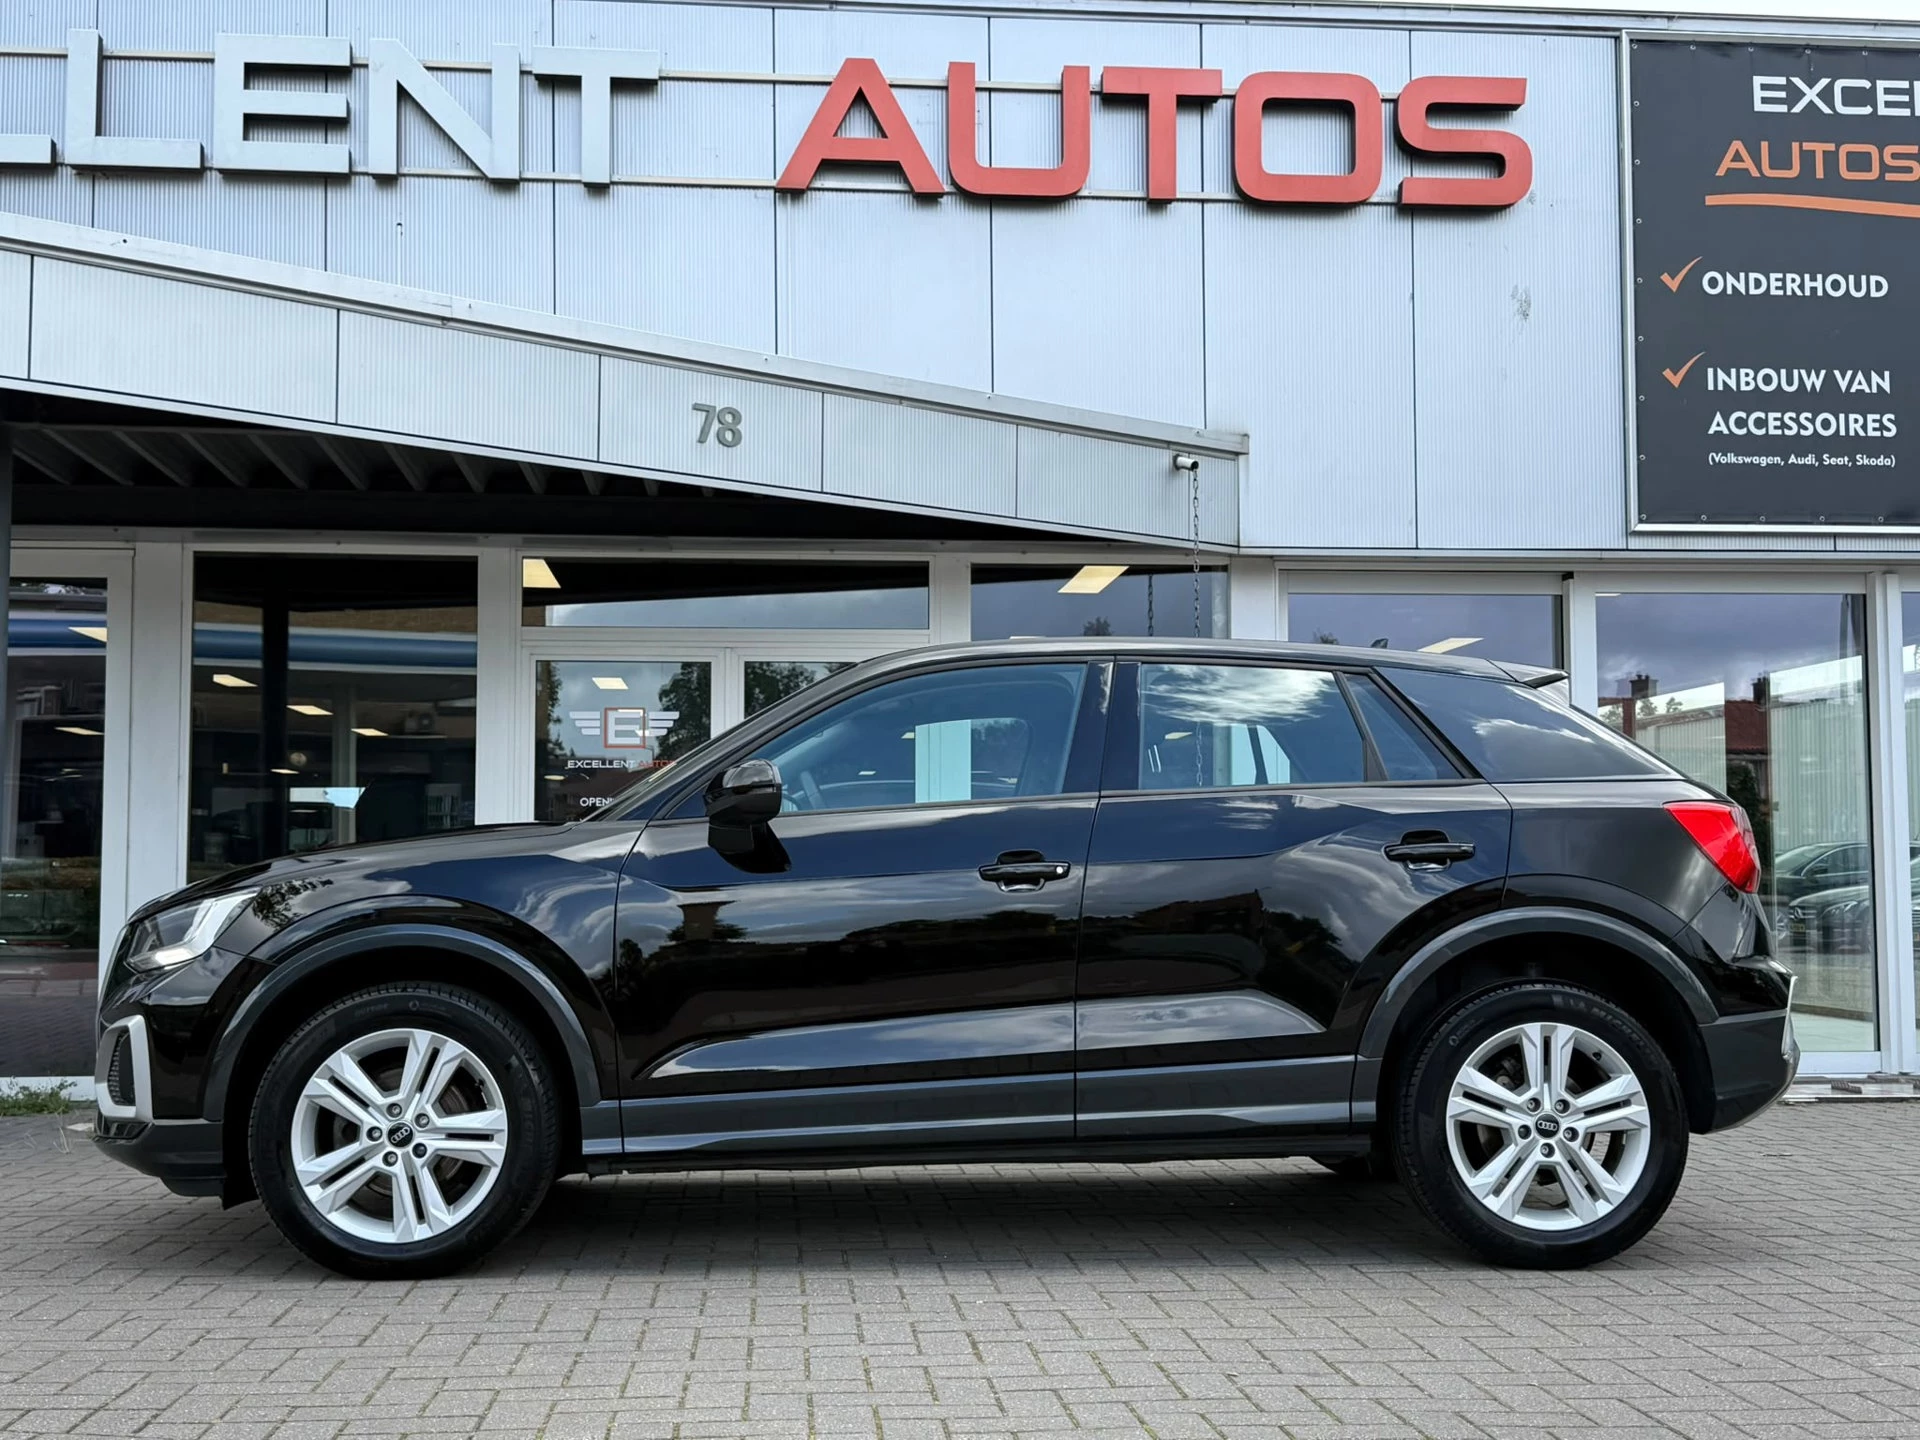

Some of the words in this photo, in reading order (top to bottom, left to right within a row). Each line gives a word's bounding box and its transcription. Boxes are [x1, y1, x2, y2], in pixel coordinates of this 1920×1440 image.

[0, 28, 661, 187] LENT
[775, 57, 1533, 209] AUTOS
[1714, 140, 1920, 182] AUTOS
[1702, 270, 1889, 298] ONDERHOUD
[1706, 367, 1826, 394] INBOUW
[1833, 369, 1891, 394] VAN
[691, 402, 743, 448] 78
[1707, 411, 1897, 438] ACCESSOIRES
[1708, 452, 1785, 467] (Volkswagen,
[1788, 453, 1819, 468] Audi,
[1822, 454, 1852, 468] Seat,
[1855, 454, 1896, 468] Skoda)
[567, 759, 636, 769] EXCELLENT
